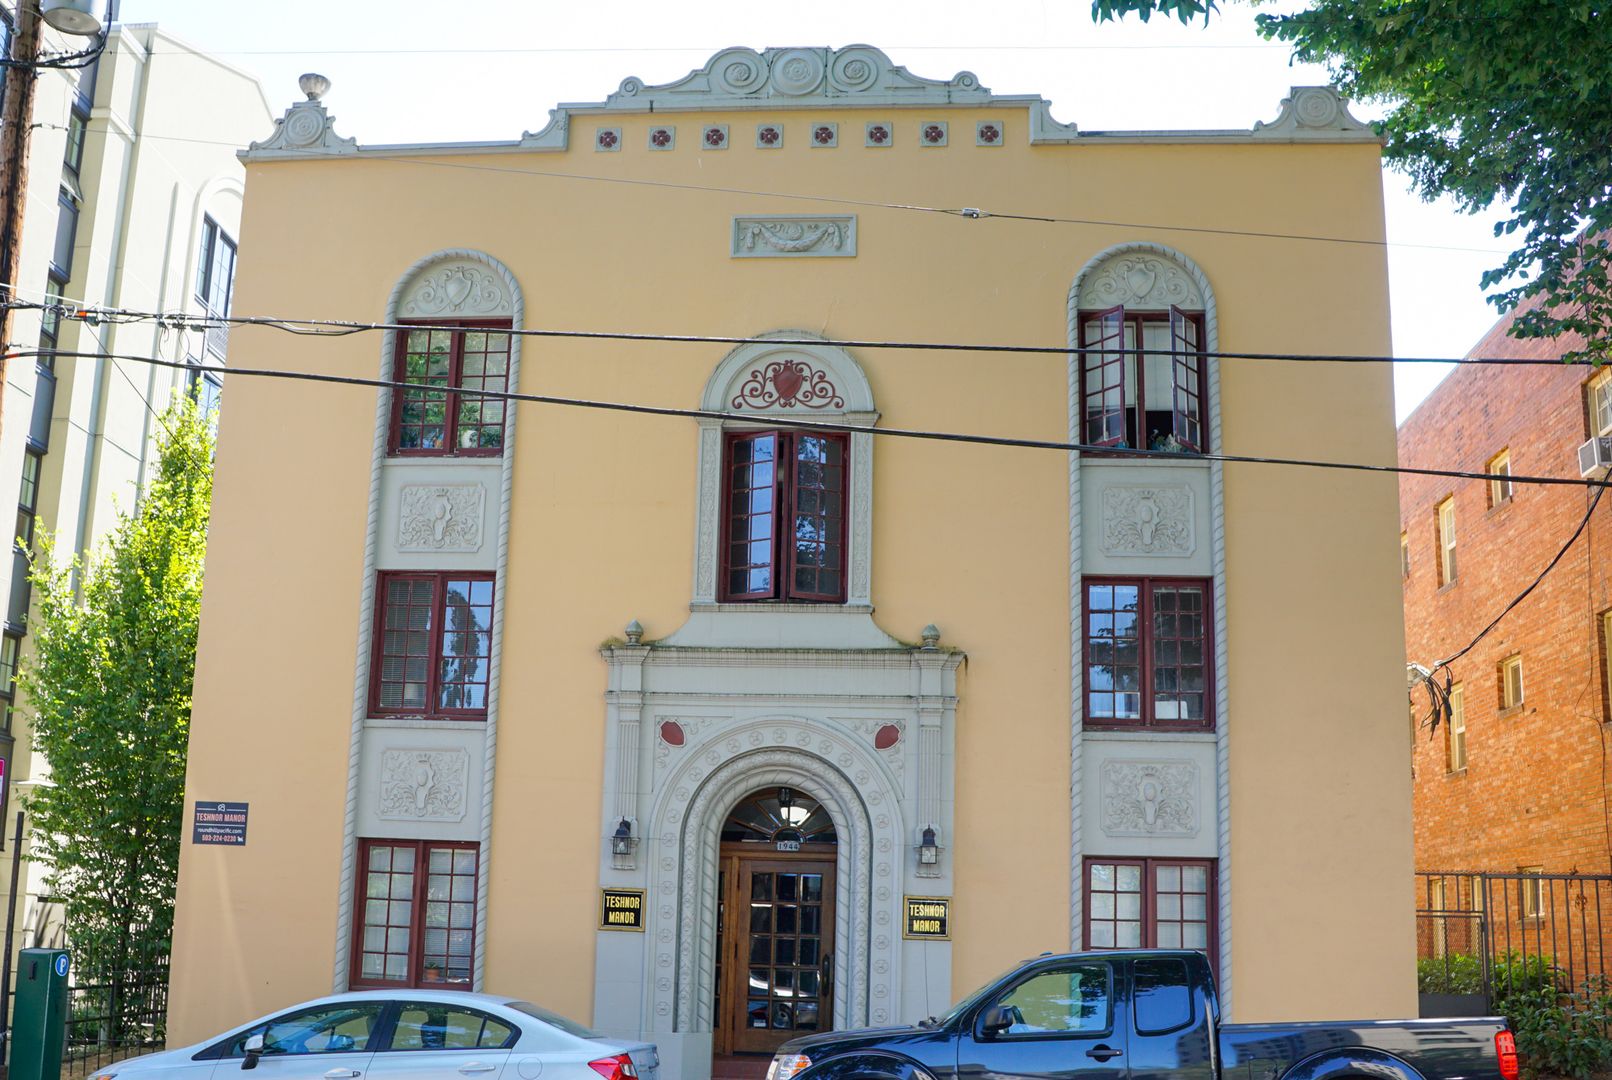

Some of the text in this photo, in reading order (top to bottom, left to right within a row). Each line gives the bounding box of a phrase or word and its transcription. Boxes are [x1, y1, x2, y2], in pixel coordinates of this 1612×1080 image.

[196, 813, 246, 823] TESHNOR MANOR
[778, 842, 799, 850] 1944
[605, 895, 640, 909] TESHNOR
[909, 904, 945, 917] TESHNOR
[608, 911, 635, 924] MANOR
[913, 919, 940, 932] MANOR
[60, 957, 67, 973] P
